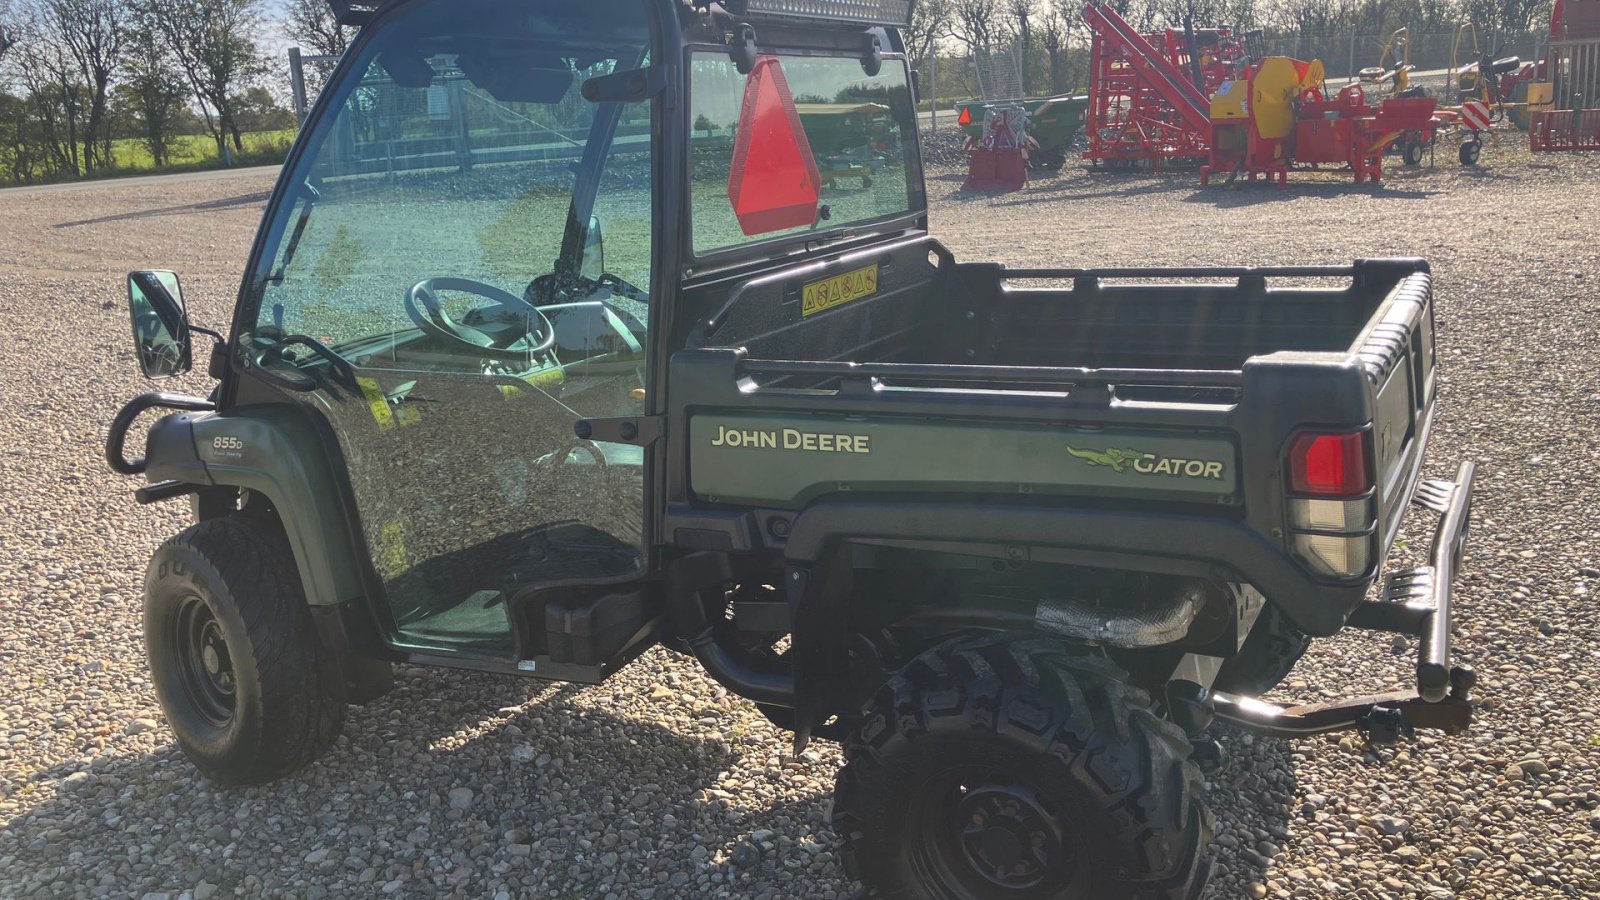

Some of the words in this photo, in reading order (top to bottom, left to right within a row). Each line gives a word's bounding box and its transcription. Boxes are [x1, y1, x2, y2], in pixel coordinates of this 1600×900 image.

[213, 436, 243, 450] 855D
[711, 425, 777, 449] JOHN
[782, 428, 870, 453] DEERE
[1133, 453, 1223, 478] GATOR
